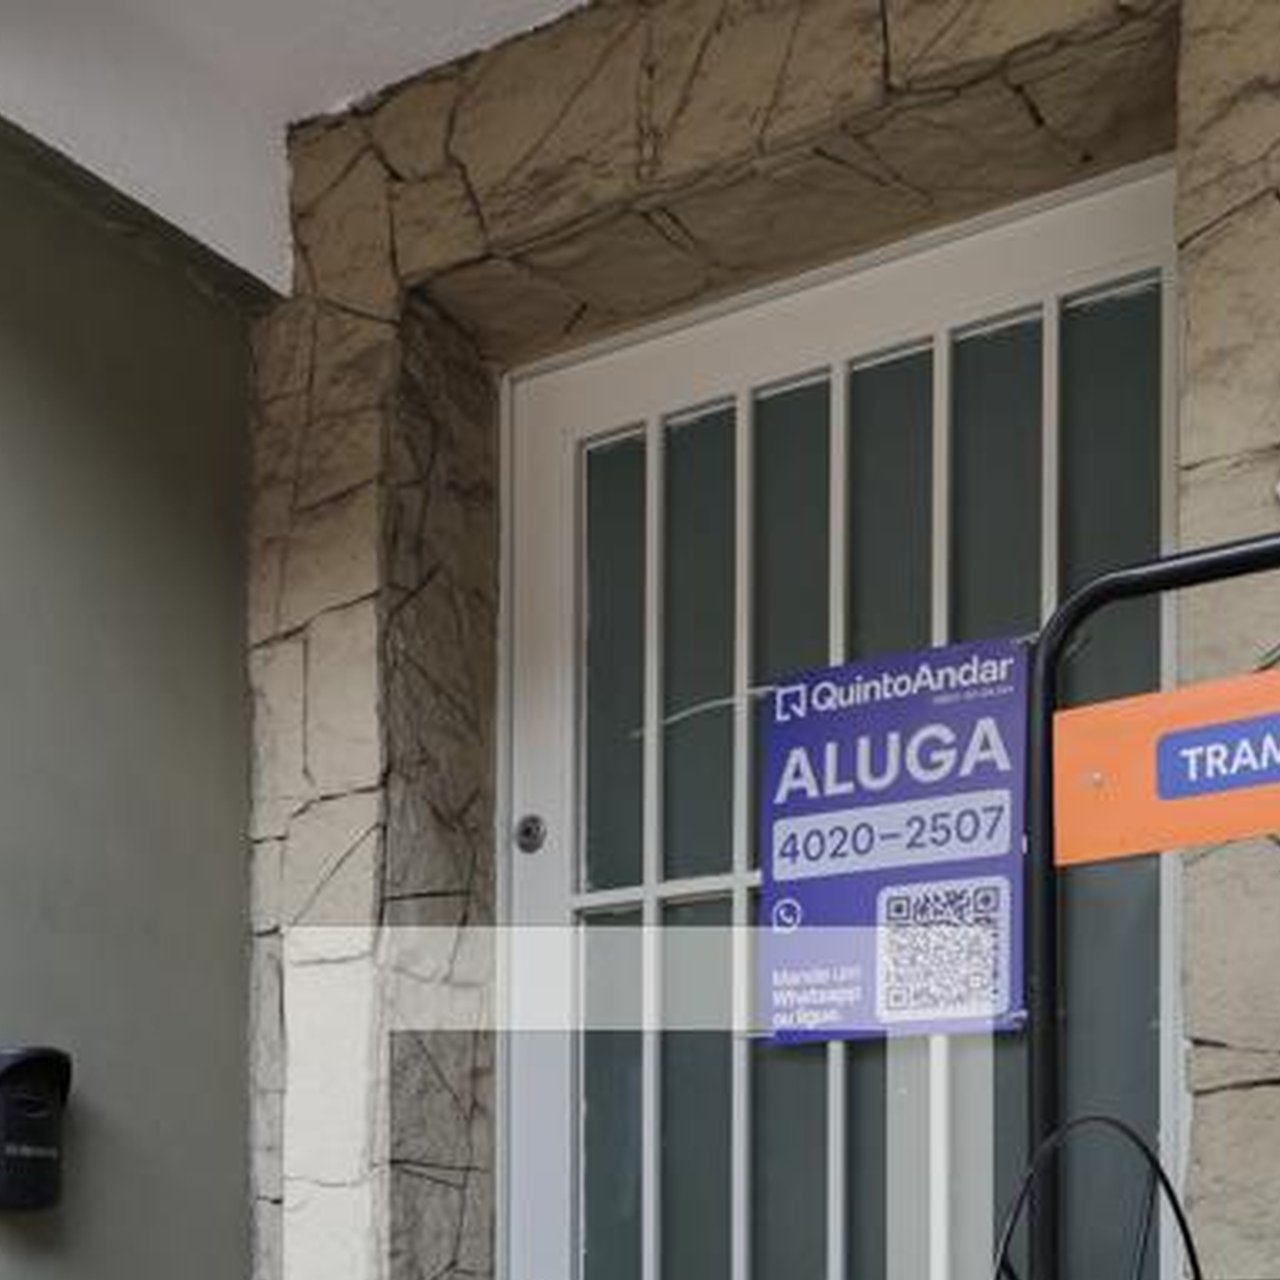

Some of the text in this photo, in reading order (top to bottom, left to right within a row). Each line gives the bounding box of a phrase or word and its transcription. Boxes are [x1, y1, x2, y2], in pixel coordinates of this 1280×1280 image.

[810, 654, 1015, 712] QuintoAndar
[772, 716, 1012, 804] ALUGA
[777, 804, 1006, 864] 4020-2507
